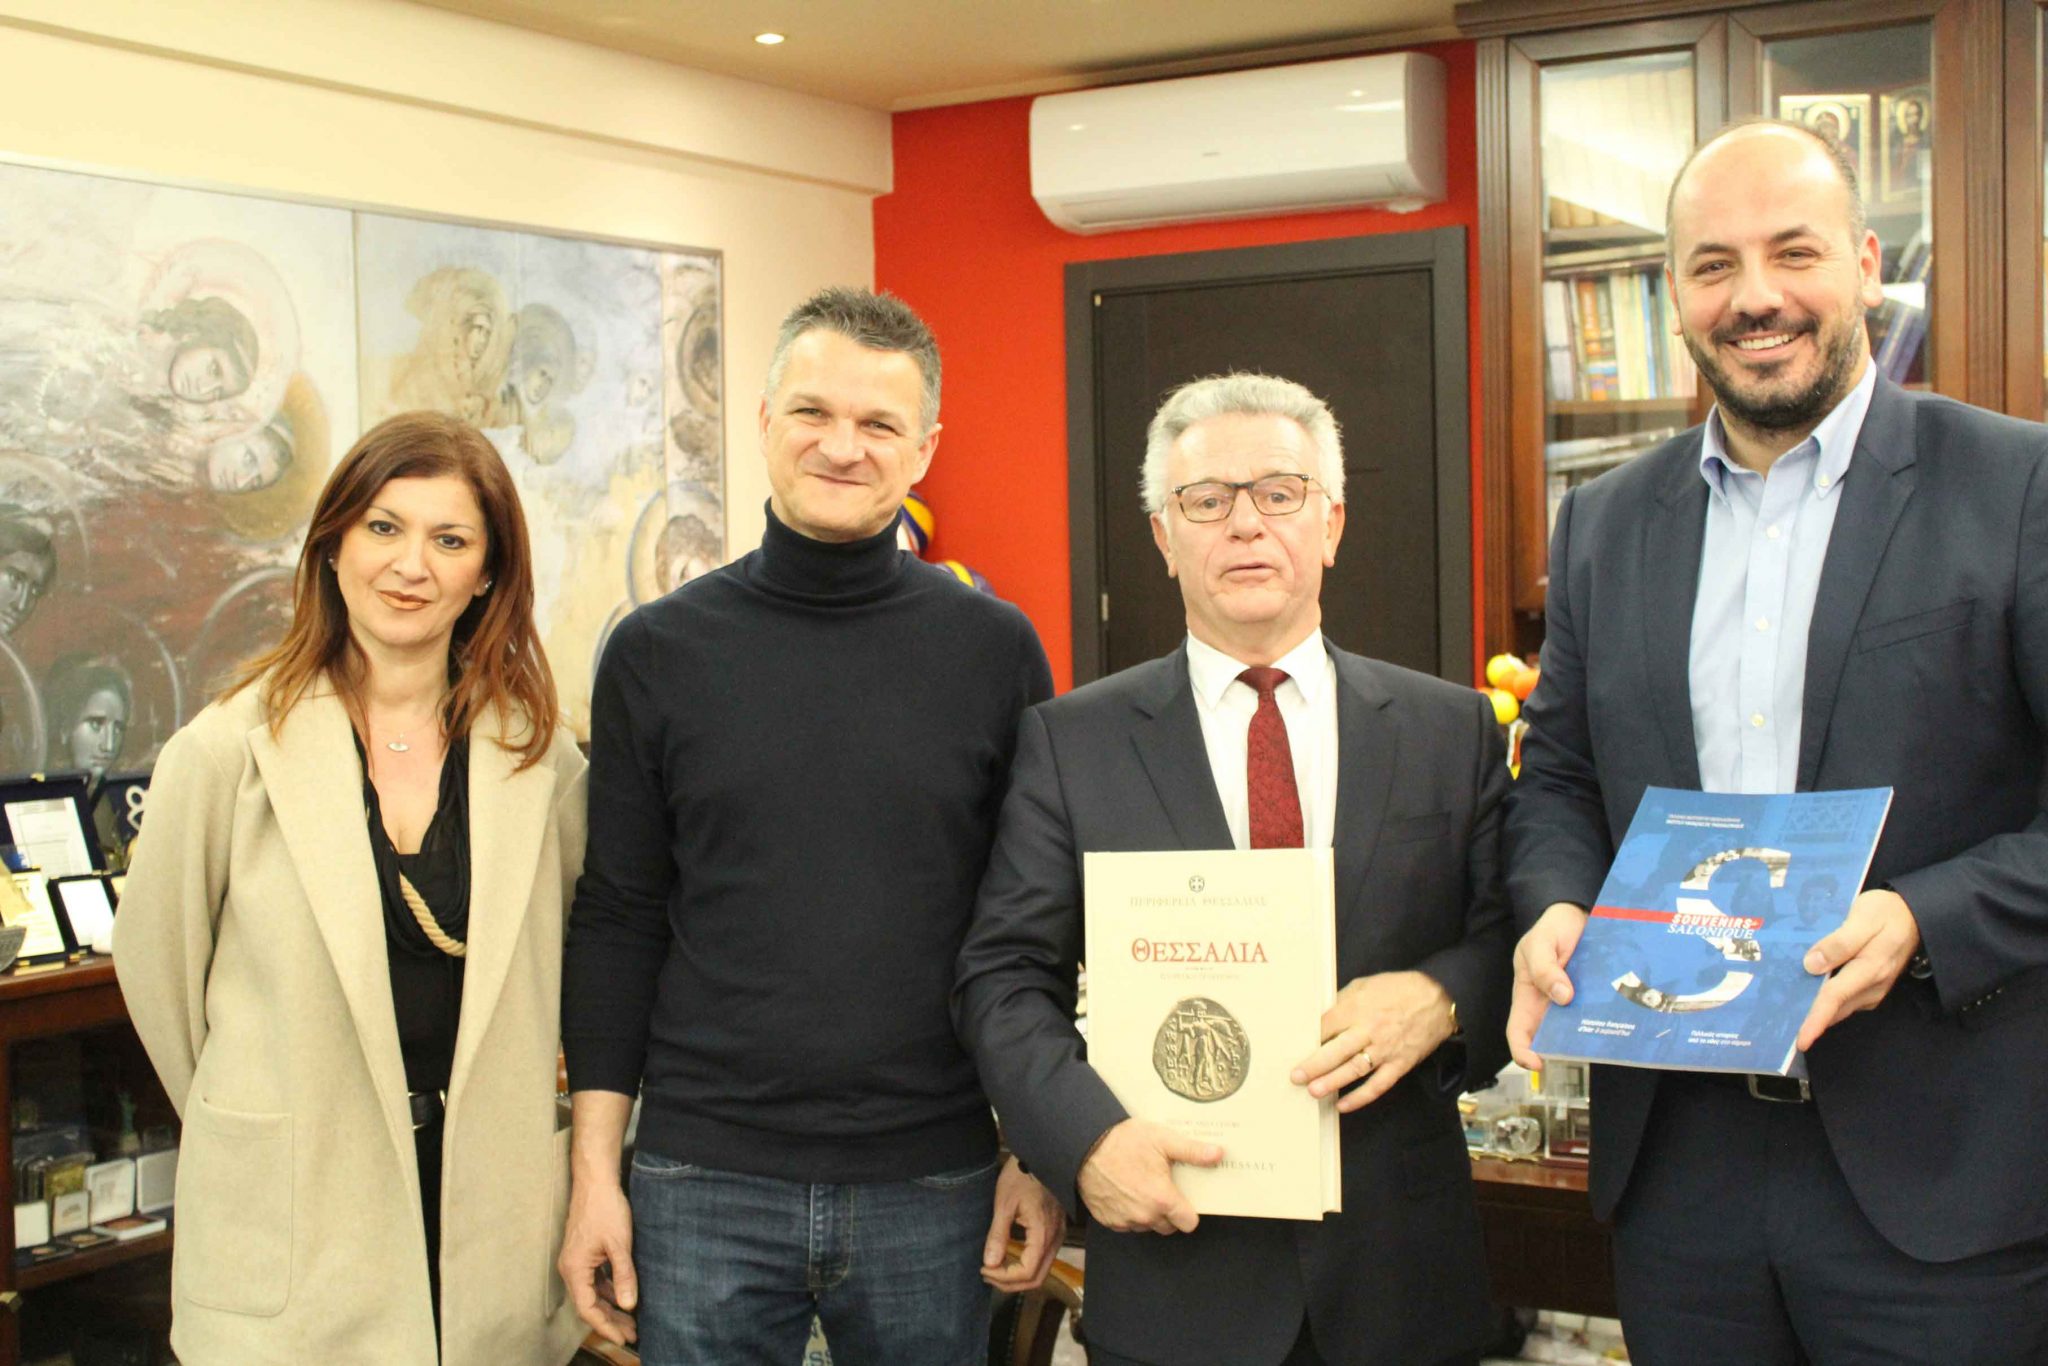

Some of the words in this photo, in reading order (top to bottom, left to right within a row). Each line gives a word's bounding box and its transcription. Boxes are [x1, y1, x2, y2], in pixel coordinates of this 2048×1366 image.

[1672, 913, 1753, 930] SOUVENIRS
[1667, 924, 1755, 939] SALONIQUE
[1131, 938, 1268, 963] ΘΕΣΣΑΛΙΑ
